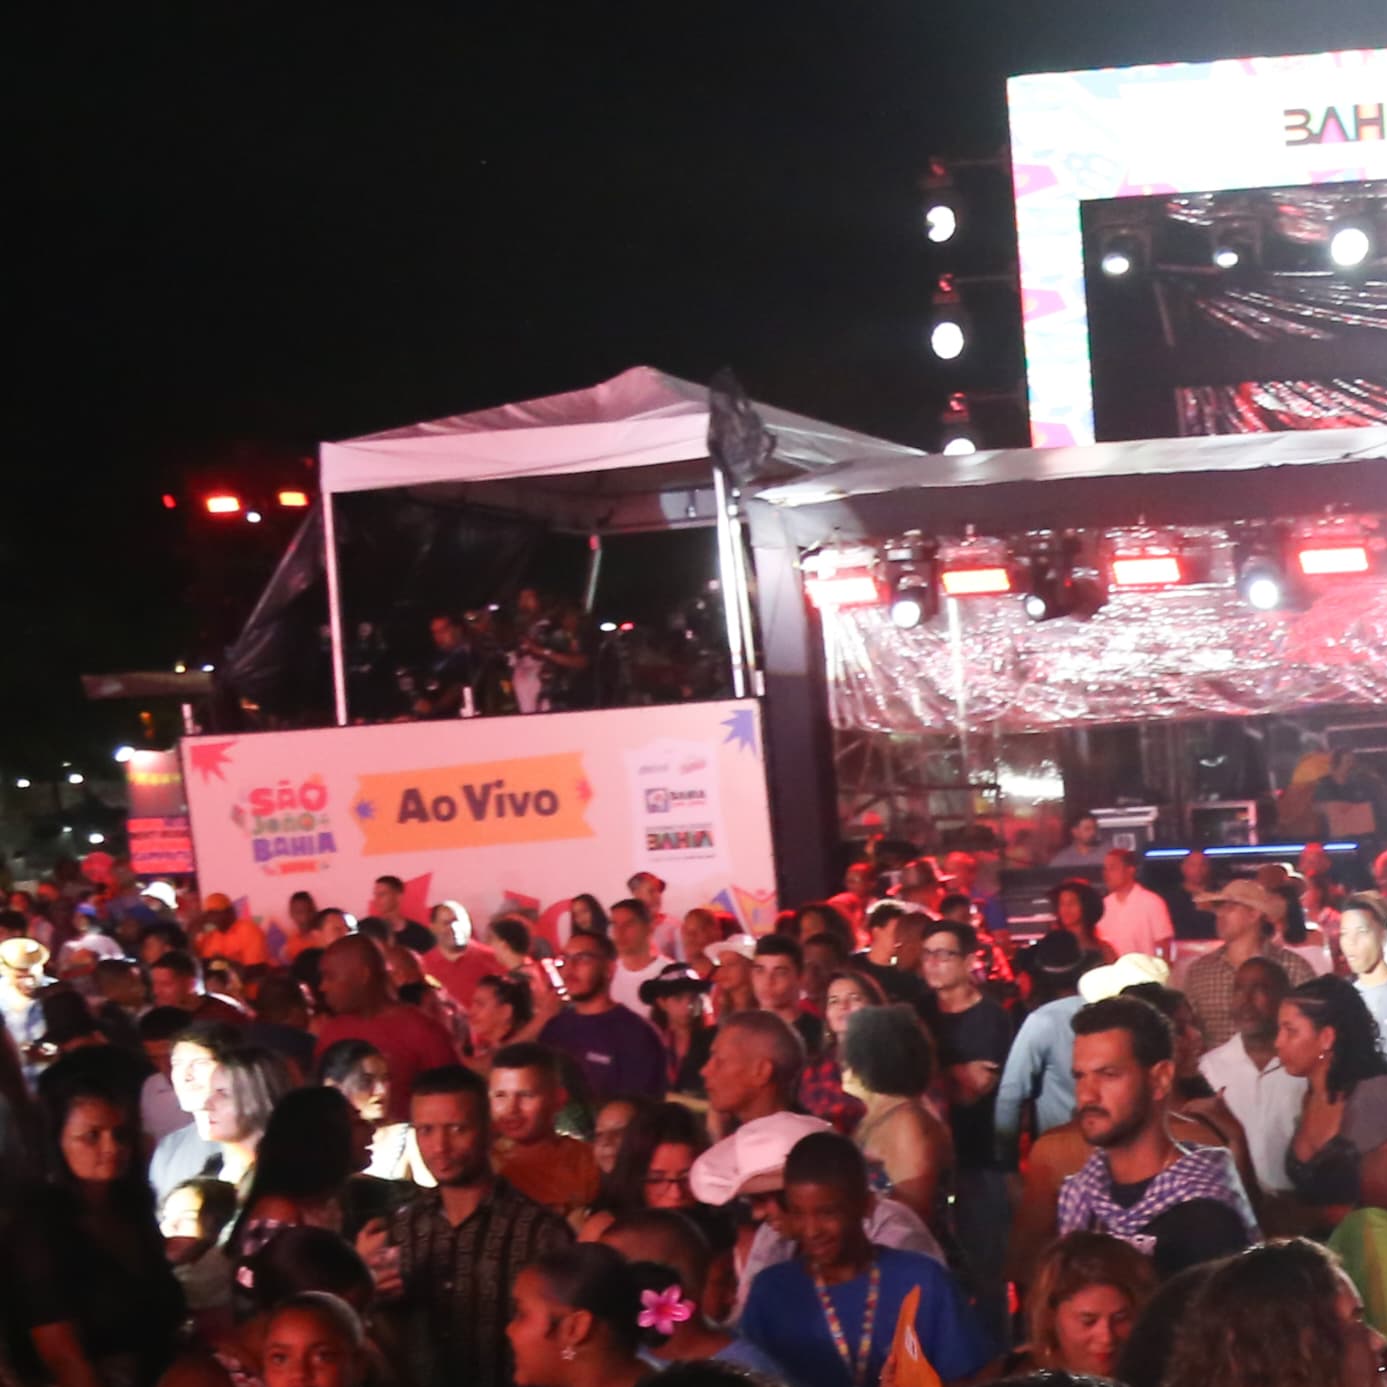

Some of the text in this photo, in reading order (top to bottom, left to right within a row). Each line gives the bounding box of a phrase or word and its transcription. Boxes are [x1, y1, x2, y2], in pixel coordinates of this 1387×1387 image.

[397, 779, 559, 824] Ao Vivo
[252, 832, 337, 863] BAHIA
